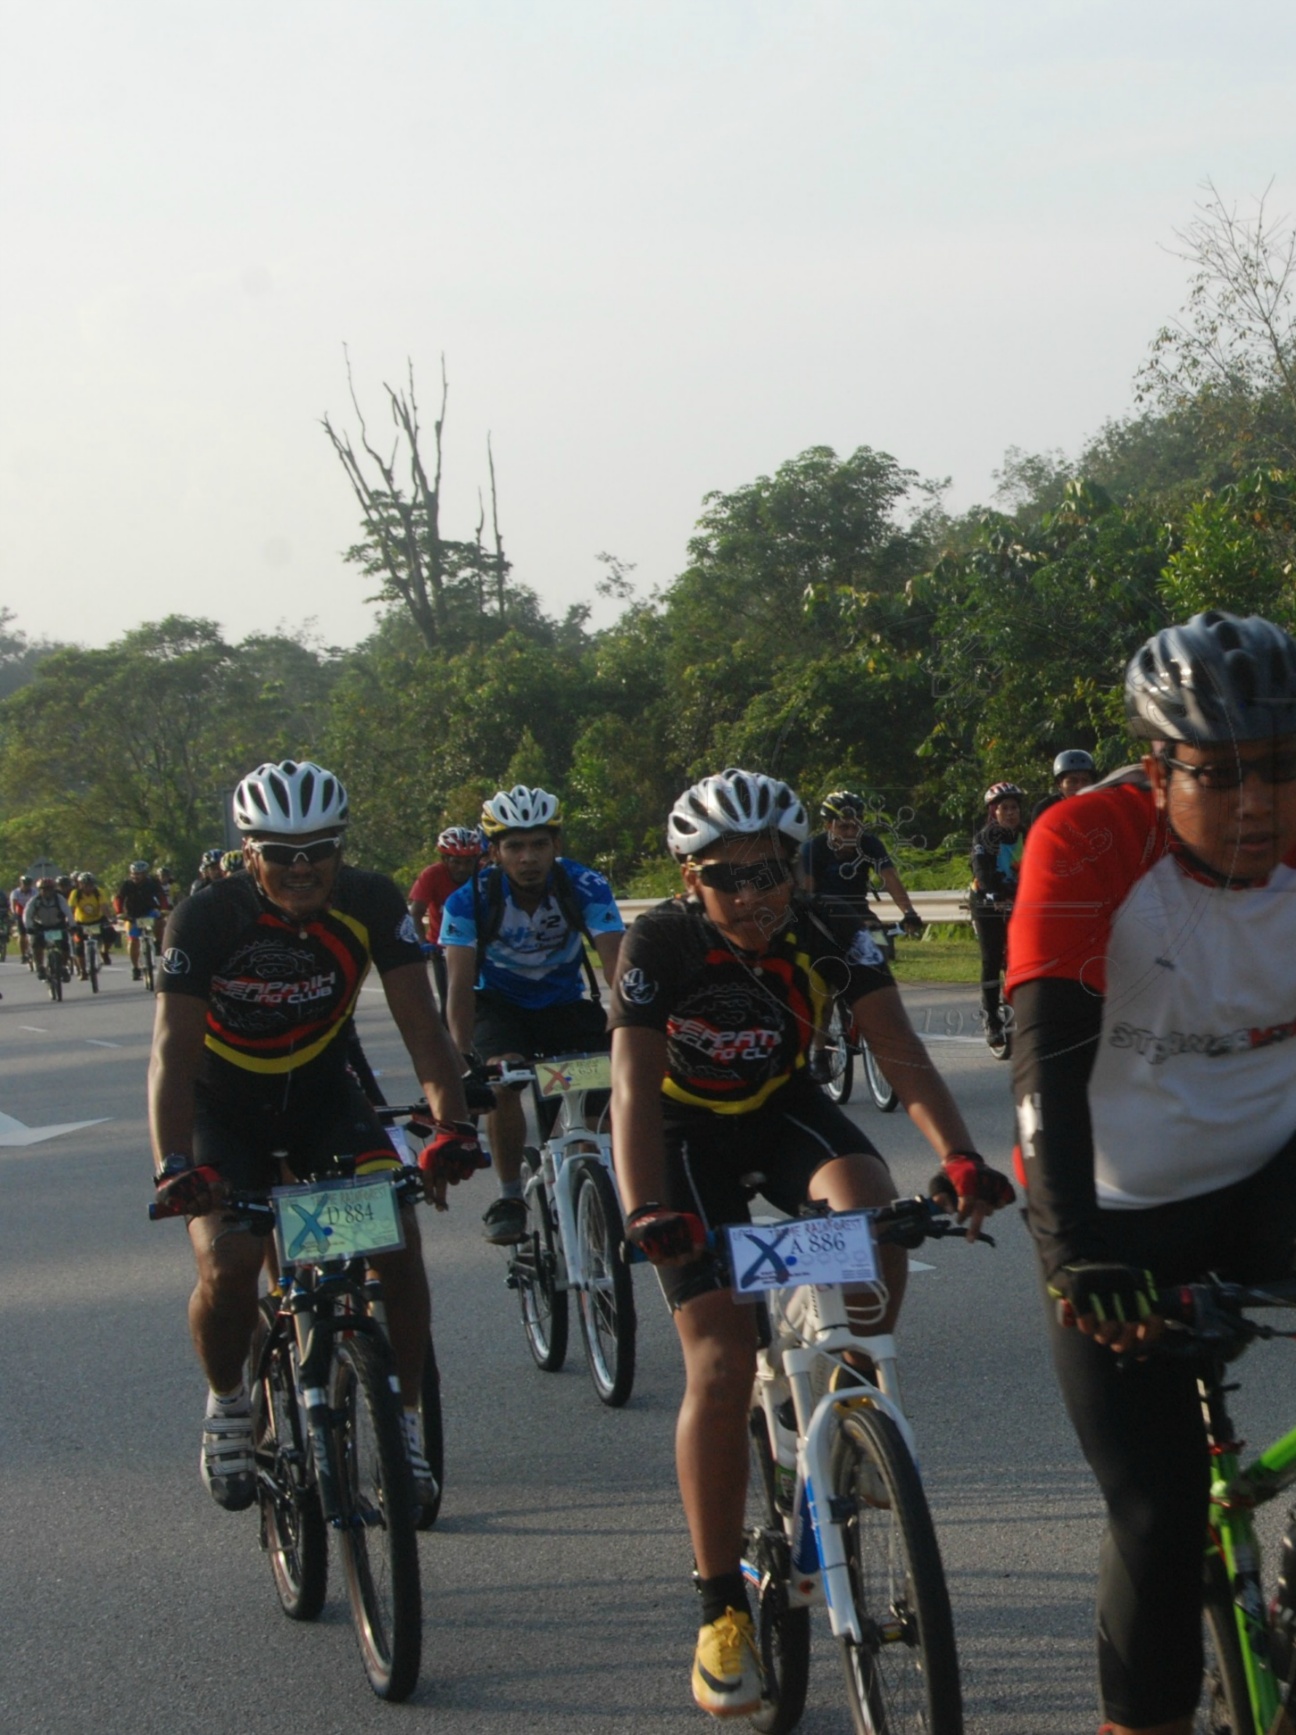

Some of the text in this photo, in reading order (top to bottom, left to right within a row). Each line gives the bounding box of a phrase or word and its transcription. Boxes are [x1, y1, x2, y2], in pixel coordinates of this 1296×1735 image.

[327, 1202, 375, 1226] D 884
[791, 1232, 846, 1255] A 886
